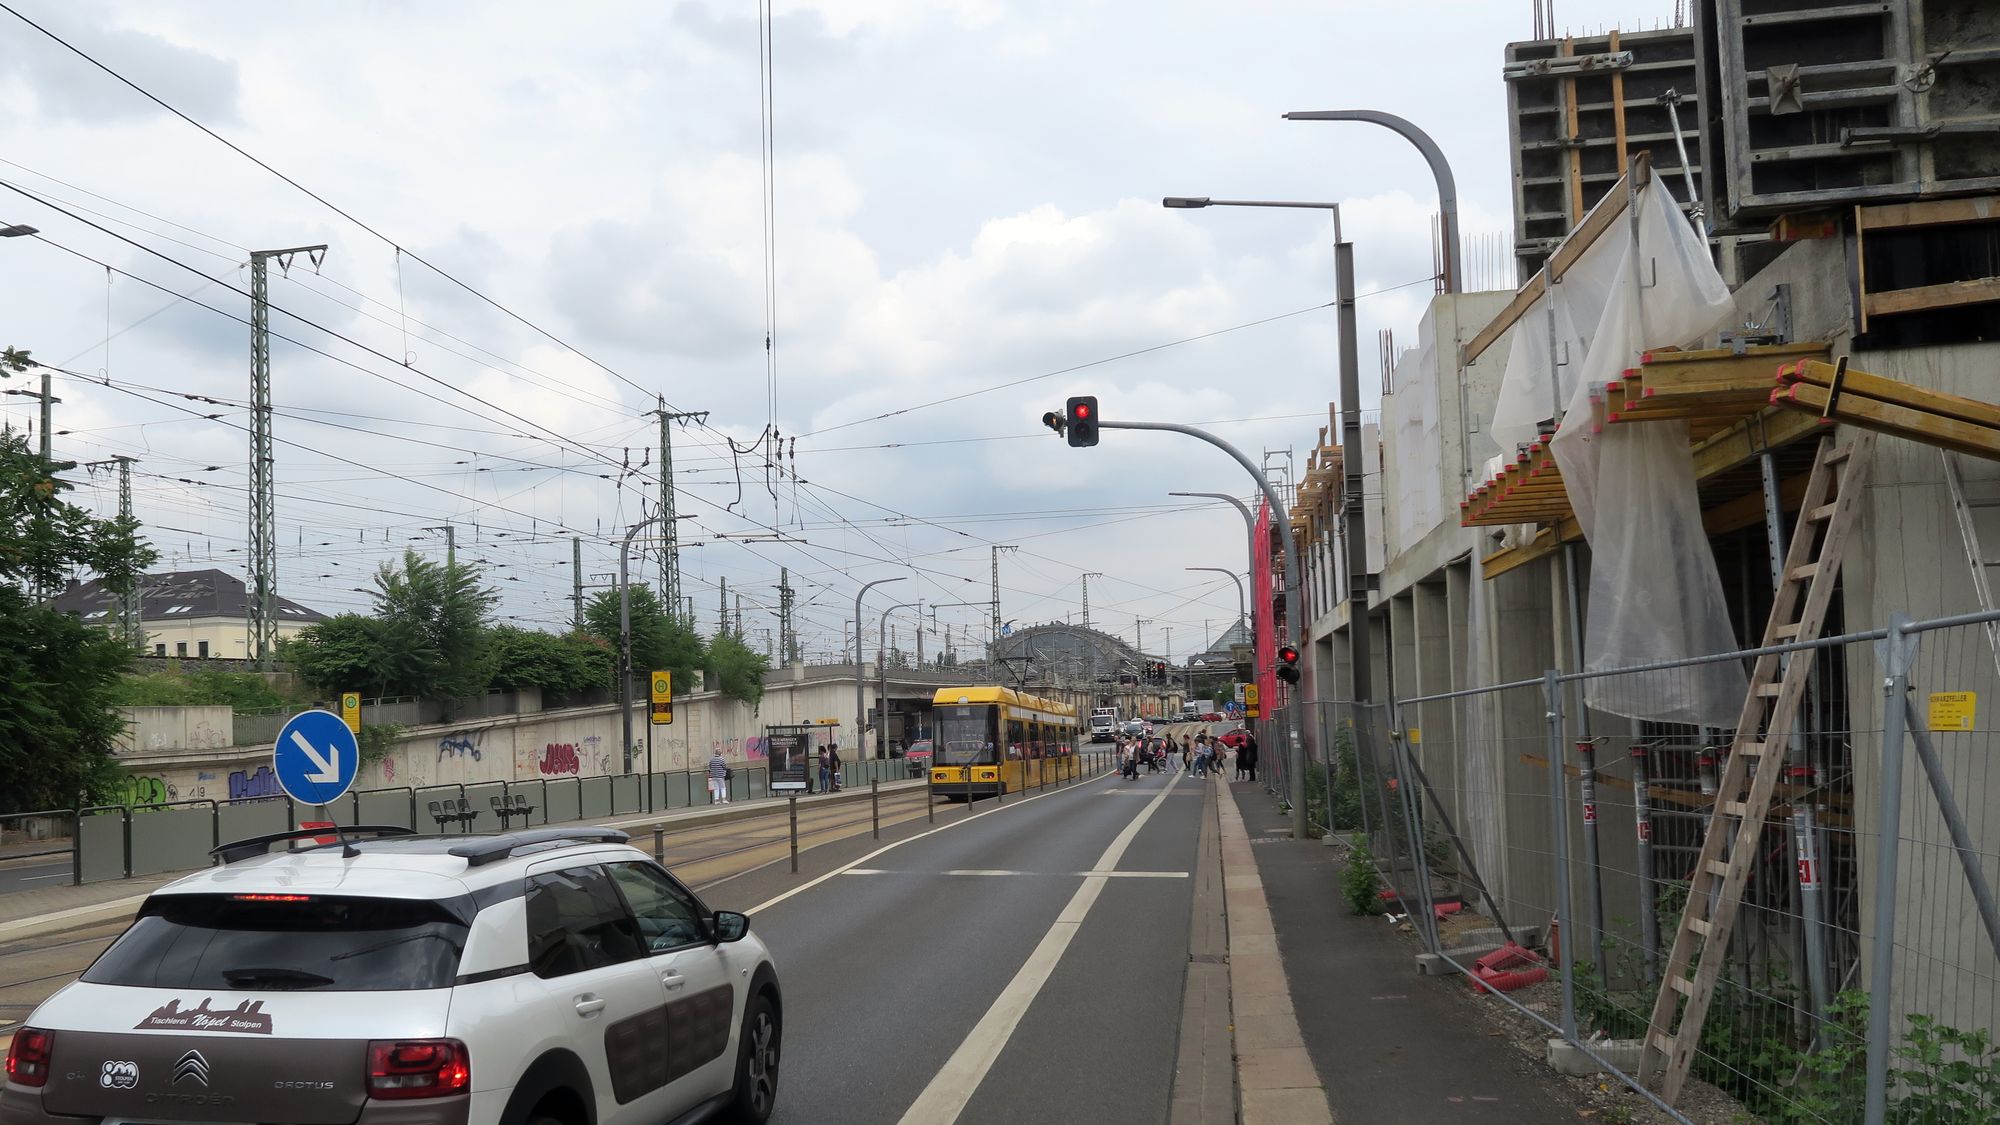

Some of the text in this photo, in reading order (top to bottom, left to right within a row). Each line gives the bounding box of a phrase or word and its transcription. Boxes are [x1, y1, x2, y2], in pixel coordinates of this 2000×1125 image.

[150, 1013, 262, 1029] Tischlerei Nöpel Stolpen
[274, 1081, 334, 1089] CACTUS
